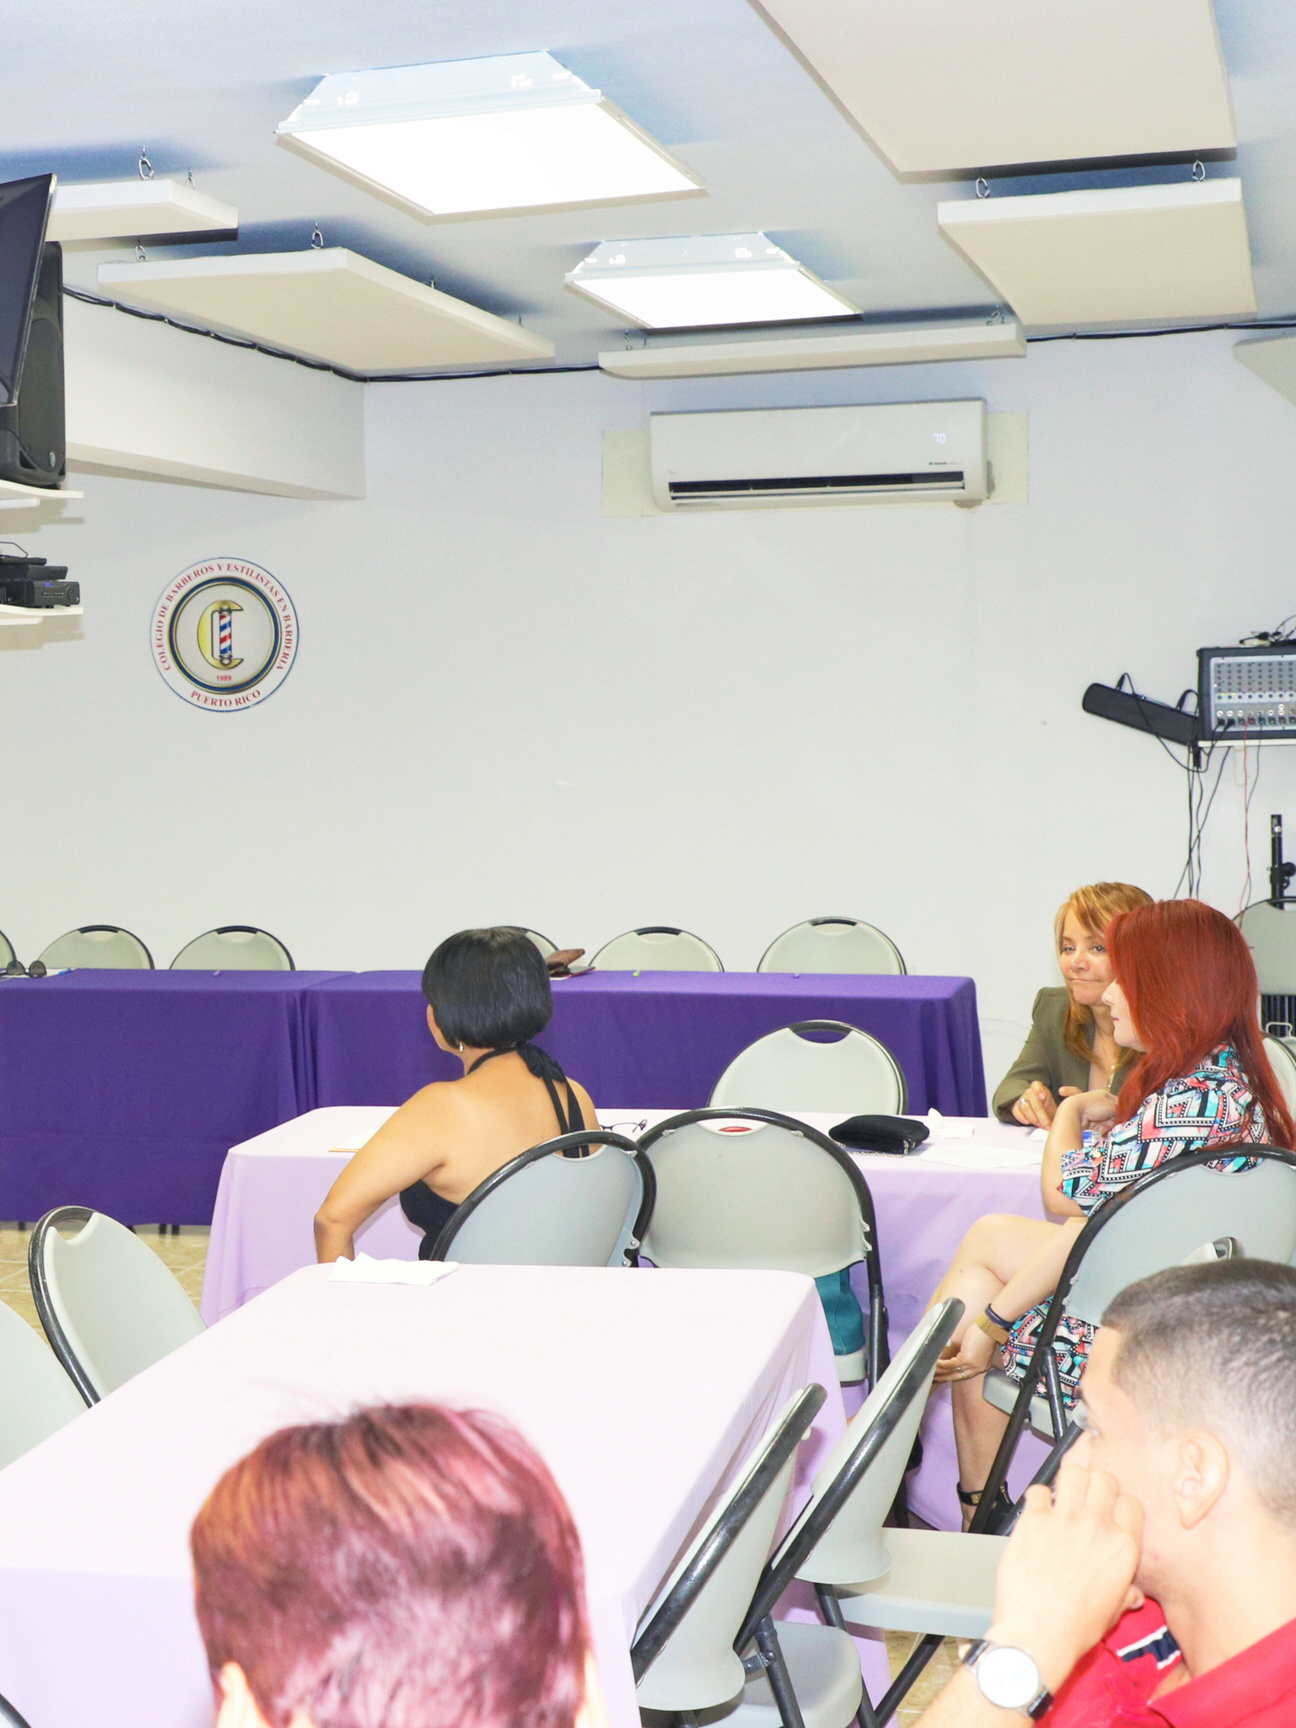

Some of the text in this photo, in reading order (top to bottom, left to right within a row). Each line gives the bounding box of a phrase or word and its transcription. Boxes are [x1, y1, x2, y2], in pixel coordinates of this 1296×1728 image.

[216, 562, 224, 571] Y
[165, 565, 214, 601] BARBEROS
[227, 563, 278, 597] ESTILISTAS
[158, 603, 170, 618] DE
[277, 597, 287, 612] EN
[155, 619, 171, 671] COLEGIO
[190, 688, 261, 708] PUERTO RICO
